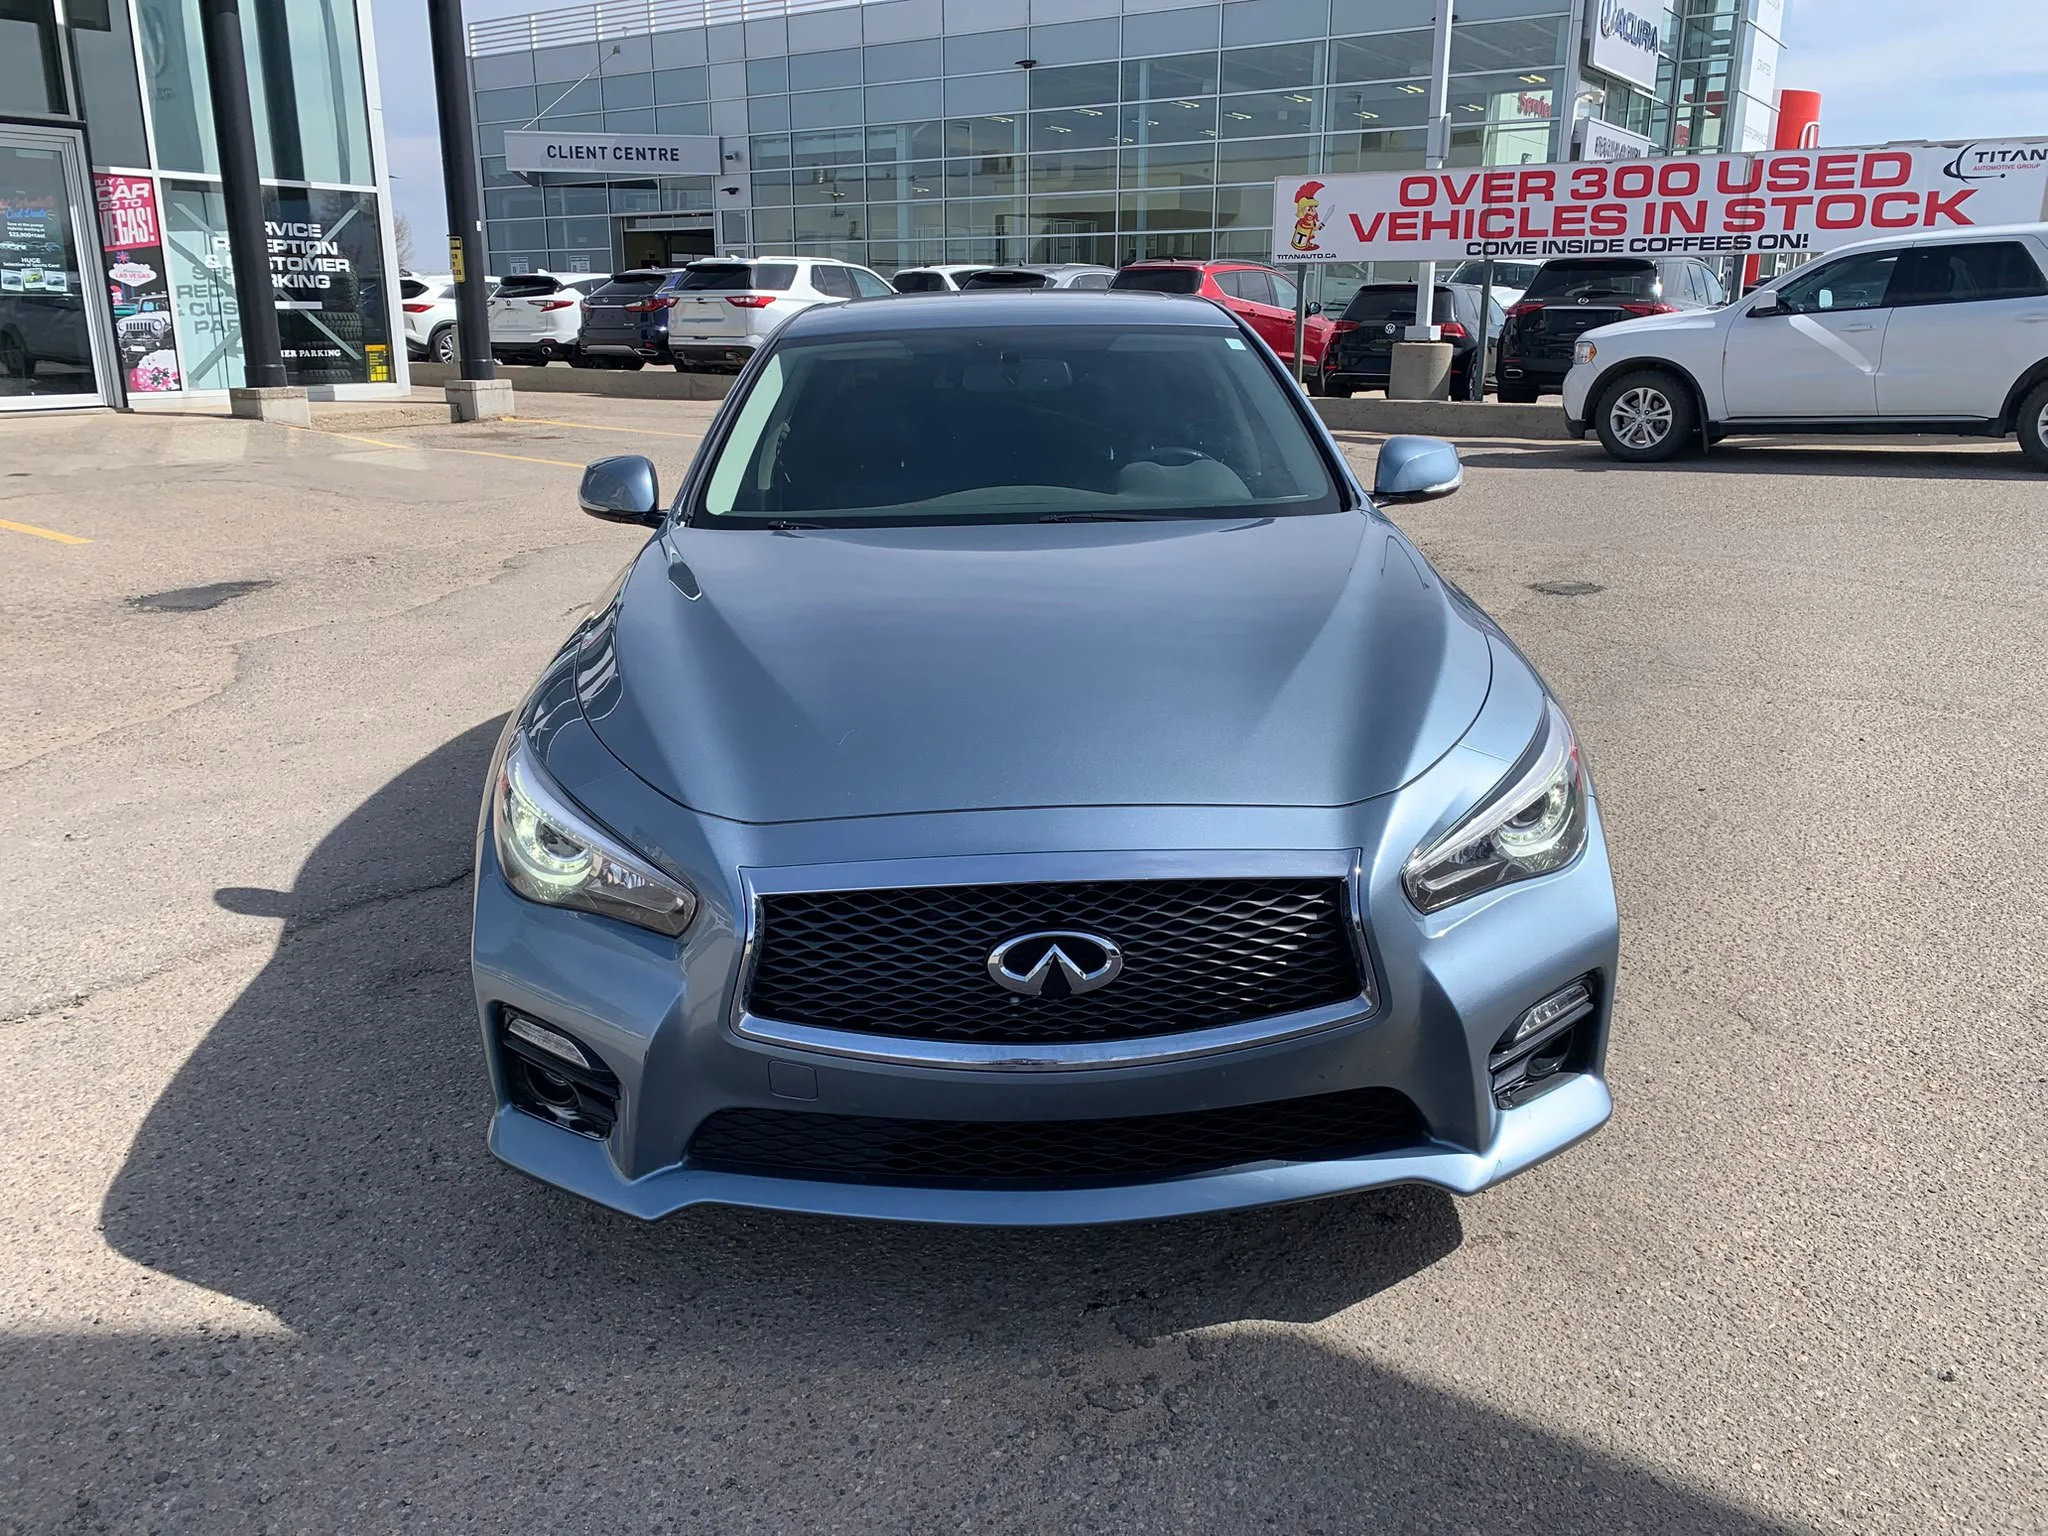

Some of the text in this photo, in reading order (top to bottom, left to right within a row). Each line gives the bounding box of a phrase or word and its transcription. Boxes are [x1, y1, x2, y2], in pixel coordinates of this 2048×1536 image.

[1615, 8, 1658, 54] ACURA
[547, 145, 680, 161] CLIENT CENTRE
[1975, 149, 2048, 163] TITAN
[1399, 151, 1912, 208] OVER 300 USED
[96, 183, 149, 201] CAR
[98, 199, 142, 210] GO TO
[1349, 188, 1979, 243] VEHICLES IN STOCK
[99, 207, 155, 246] VEGAS!
[264, 221, 322, 237] RVICE
[1297, 232, 1307, 244] T
[1466, 233, 1809, 256] COME INSIDE COFFEES ON!
[271, 273, 331, 289] RKING
[299, 349, 341, 357] PARKING
